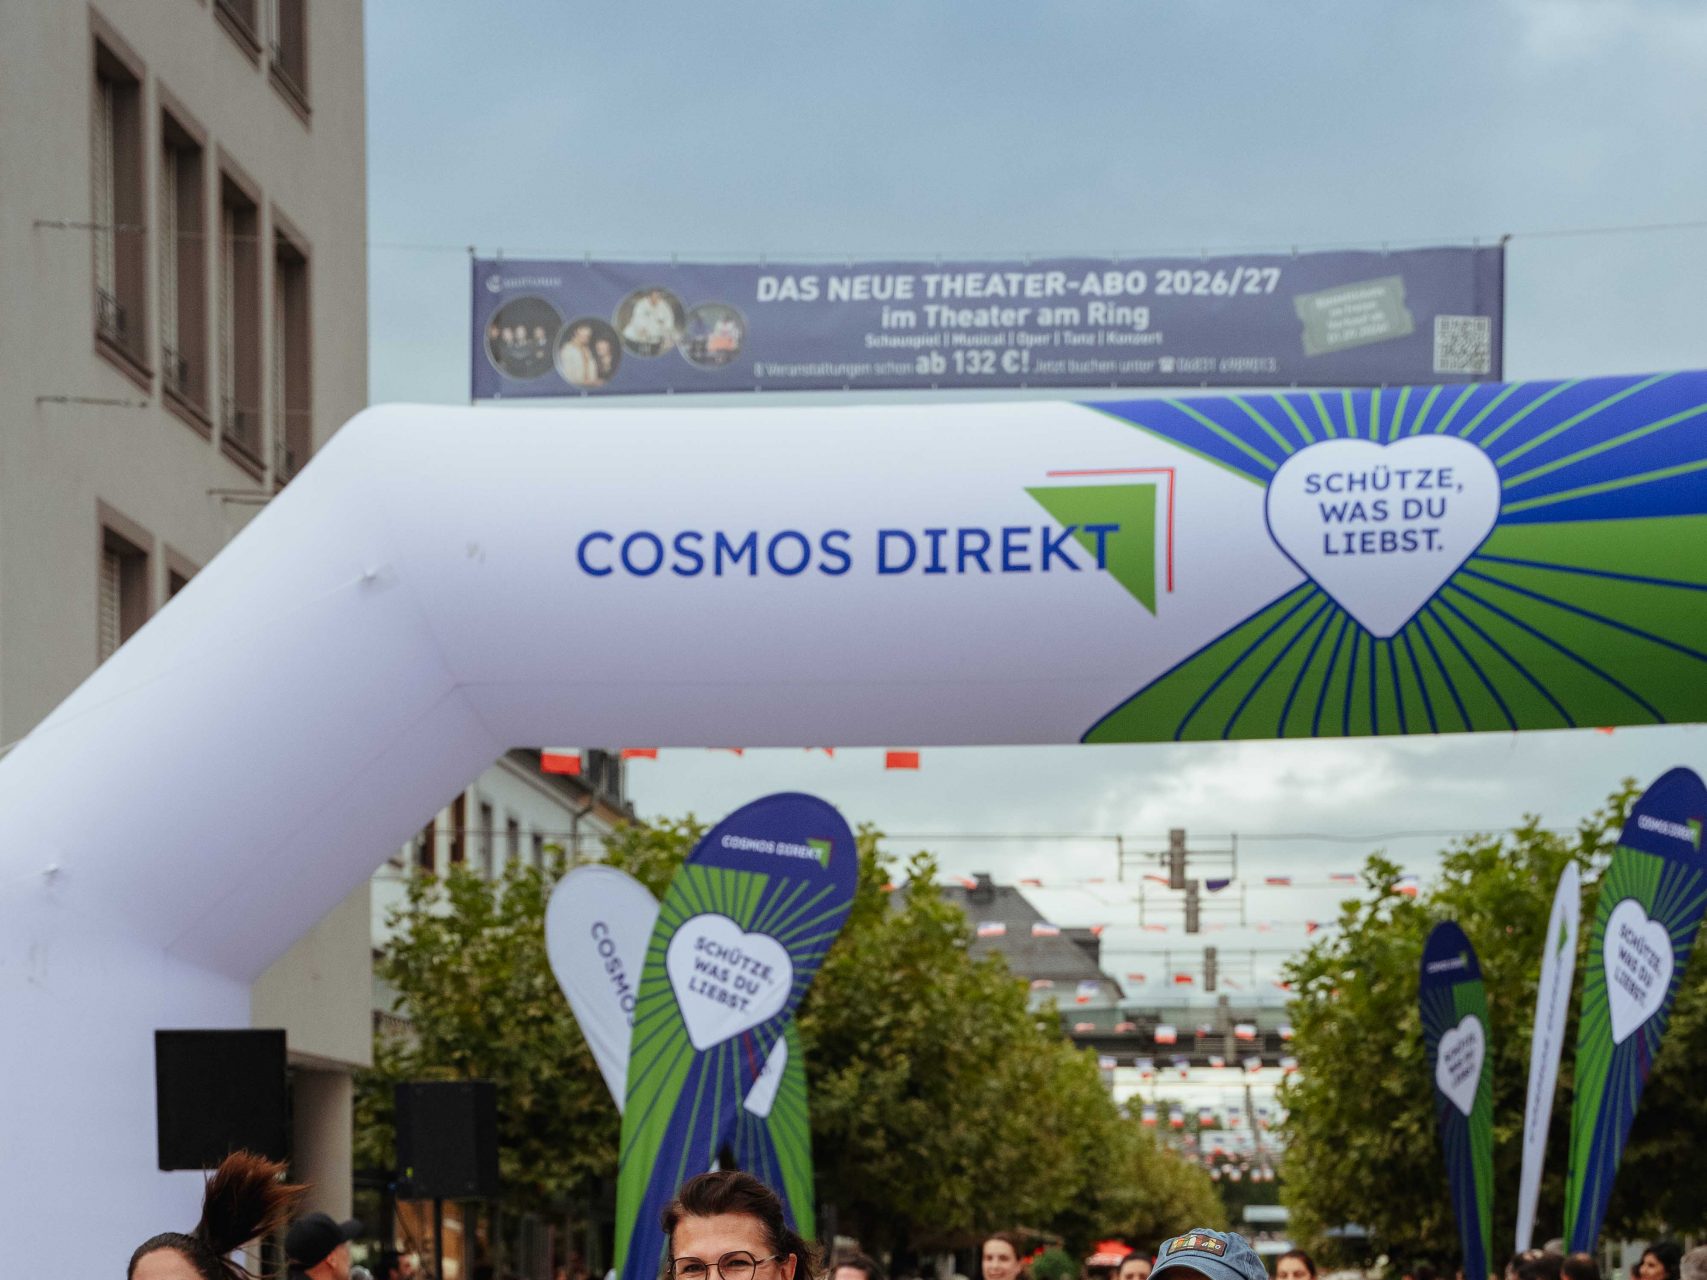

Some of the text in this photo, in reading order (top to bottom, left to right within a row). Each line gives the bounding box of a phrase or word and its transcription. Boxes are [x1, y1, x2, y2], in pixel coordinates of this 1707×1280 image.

[757, 266, 1281, 302] DAS NEUE THEATER-ABO 2026/27
[881, 301, 1150, 331] im Theater am Ring
[915, 350, 947, 375] ab
[952, 349, 997, 375] 132
[1303, 465, 1464, 496] SCHÜTZE,
[1318, 494, 1447, 525] WAS DU
[577, 522, 1120, 578] COSMOS DIREKT
[1323, 527, 1444, 557] LIEBST.
[591, 921, 636, 1028] COSMO
[694, 956, 760, 995] WAS DU
